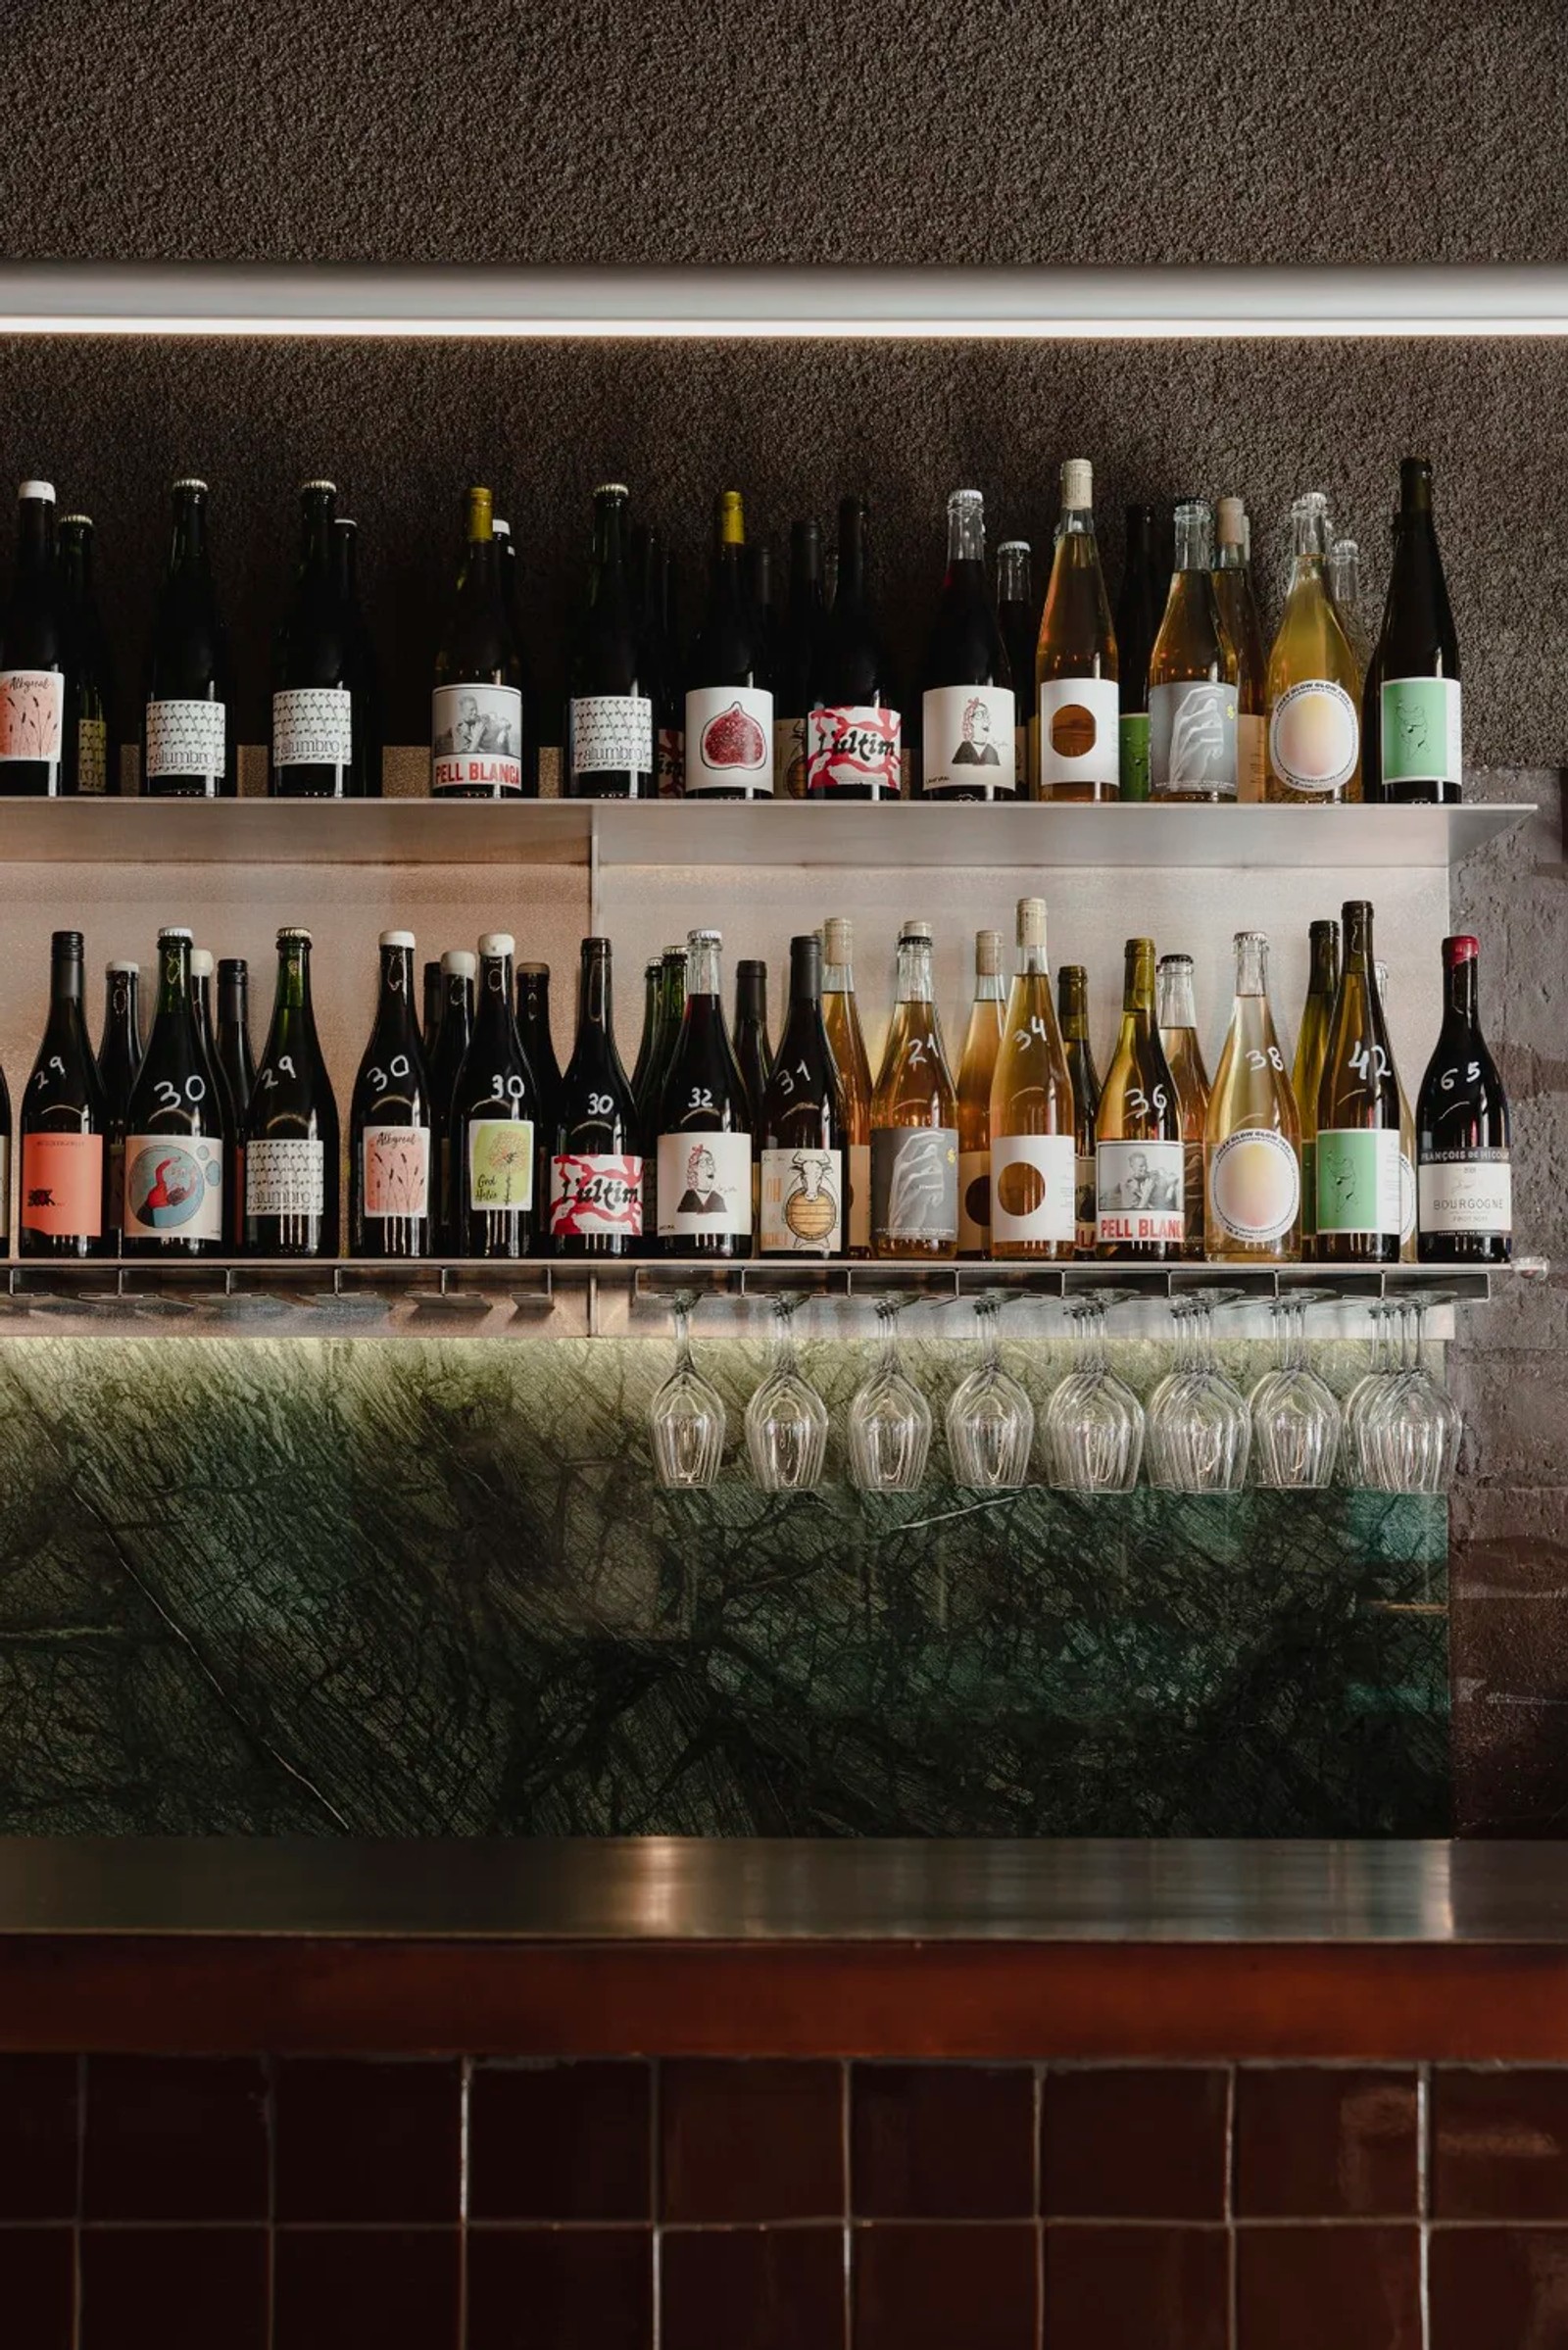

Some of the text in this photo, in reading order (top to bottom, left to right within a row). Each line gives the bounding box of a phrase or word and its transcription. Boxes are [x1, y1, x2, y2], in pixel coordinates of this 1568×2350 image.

[154, 749, 215, 764] alumbro
[280, 737, 340, 754] alumbro
[584, 745, 643, 761] alumbro
[436, 762, 519, 785] PELL BLANCA
[1013, 1015, 1047, 1052] 34
[907, 1033, 939, 1065] 21
[1246, 1047, 1284, 1071] 38
[1348, 1041, 1392, 1080] 42
[34, 1056, 66, 1090] 29
[262, 1055, 297, 1089] 29
[367, 1054, 410, 1092] 30
[776, 1059, 810, 1096] 31
[1441, 1061, 1481, 1091] 65
[154, 1074, 206, 1109] 30
[490, 1074, 525, 1100] 30
[688, 1087, 713, 1108] 32
[587, 1092, 614, 1115] 30
[1124, 1084, 1167, 1119] 36
[252, 1189, 312, 1205] alumbro
[1433, 1198, 1504, 1210] BOURGOGNE
[1101, 1218, 1133, 1238] PELL
